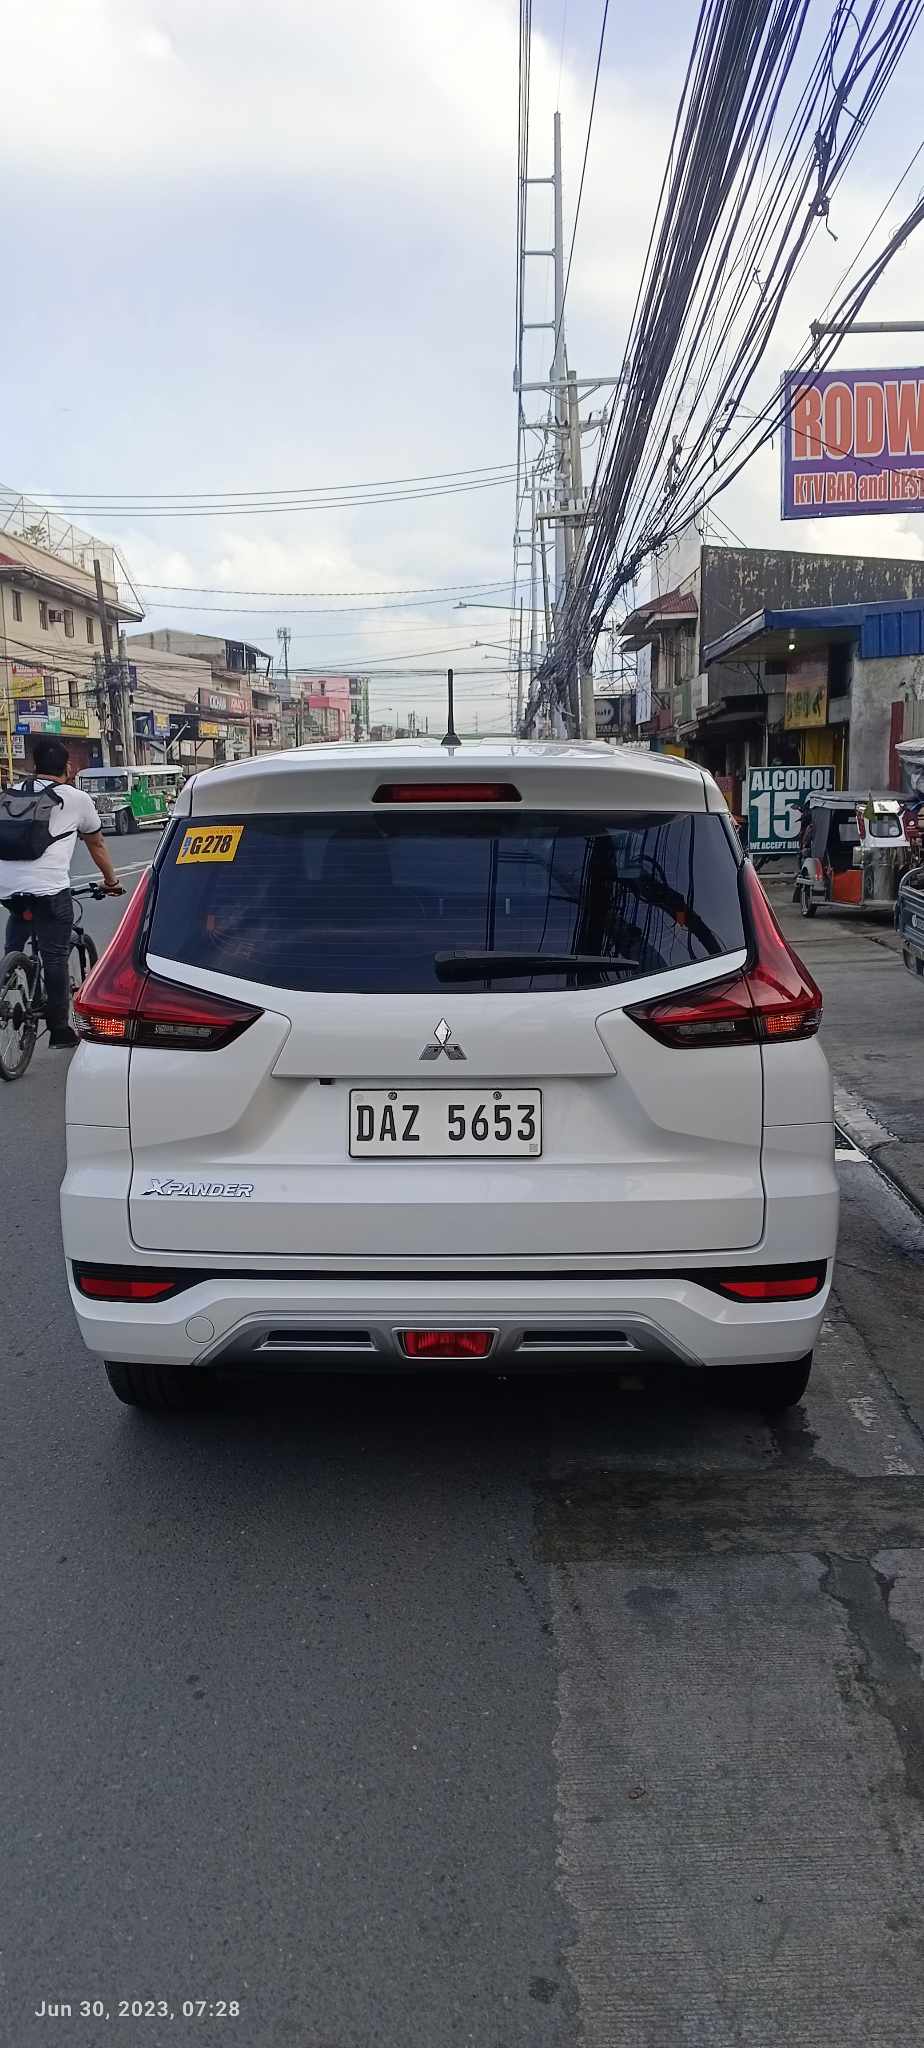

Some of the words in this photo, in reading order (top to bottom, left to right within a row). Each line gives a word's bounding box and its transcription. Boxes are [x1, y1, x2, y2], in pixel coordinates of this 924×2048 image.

[794, 472, 825, 505] KTV
[826, 471, 857, 504] BAR
[858, 469, 889, 502] and
[751, 769, 833, 791] ALCOHOL
[190, 835, 233, 855] G278
[750, 842, 760, 850] WE
[761, 841, 786, 850] ACCEPT
[356, 1105, 420, 1141] DAZ
[448, 1104, 536, 1141] 5653
[141, 1178, 254, 1198] XPANDER
